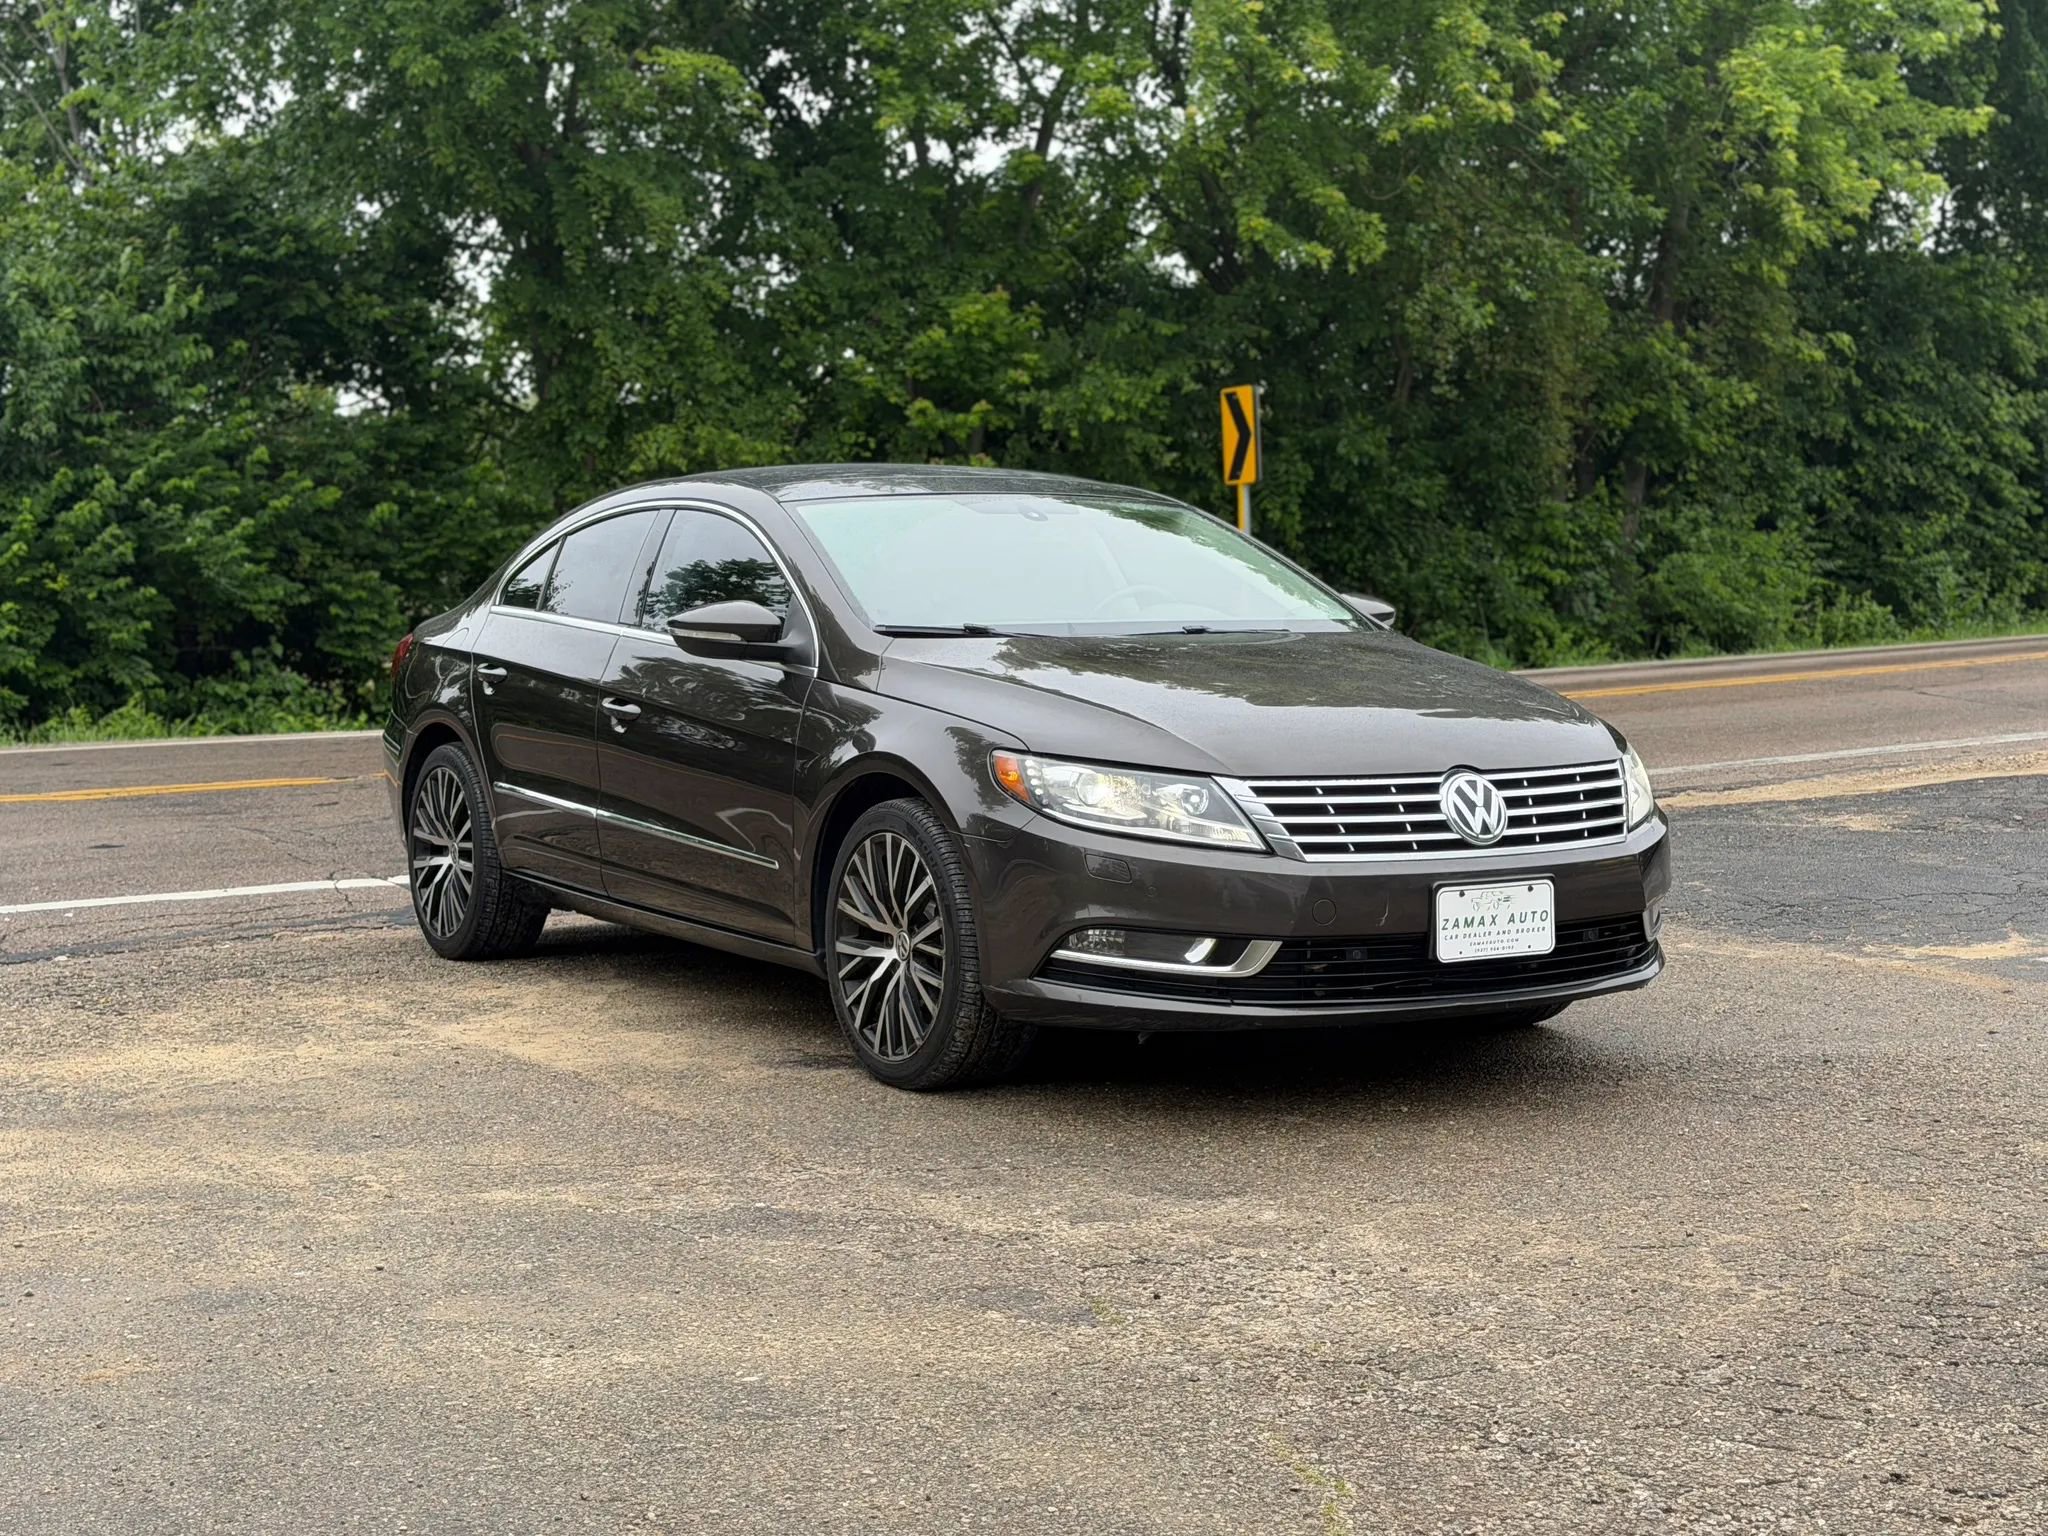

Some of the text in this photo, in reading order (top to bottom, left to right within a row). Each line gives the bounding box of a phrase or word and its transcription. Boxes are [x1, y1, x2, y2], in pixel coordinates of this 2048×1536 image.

[1441, 909, 1549, 931] ZAMAX AUTO
[1463, 930, 1492, 940] DEALER
[1515, 926, 1546, 934] BROKER
